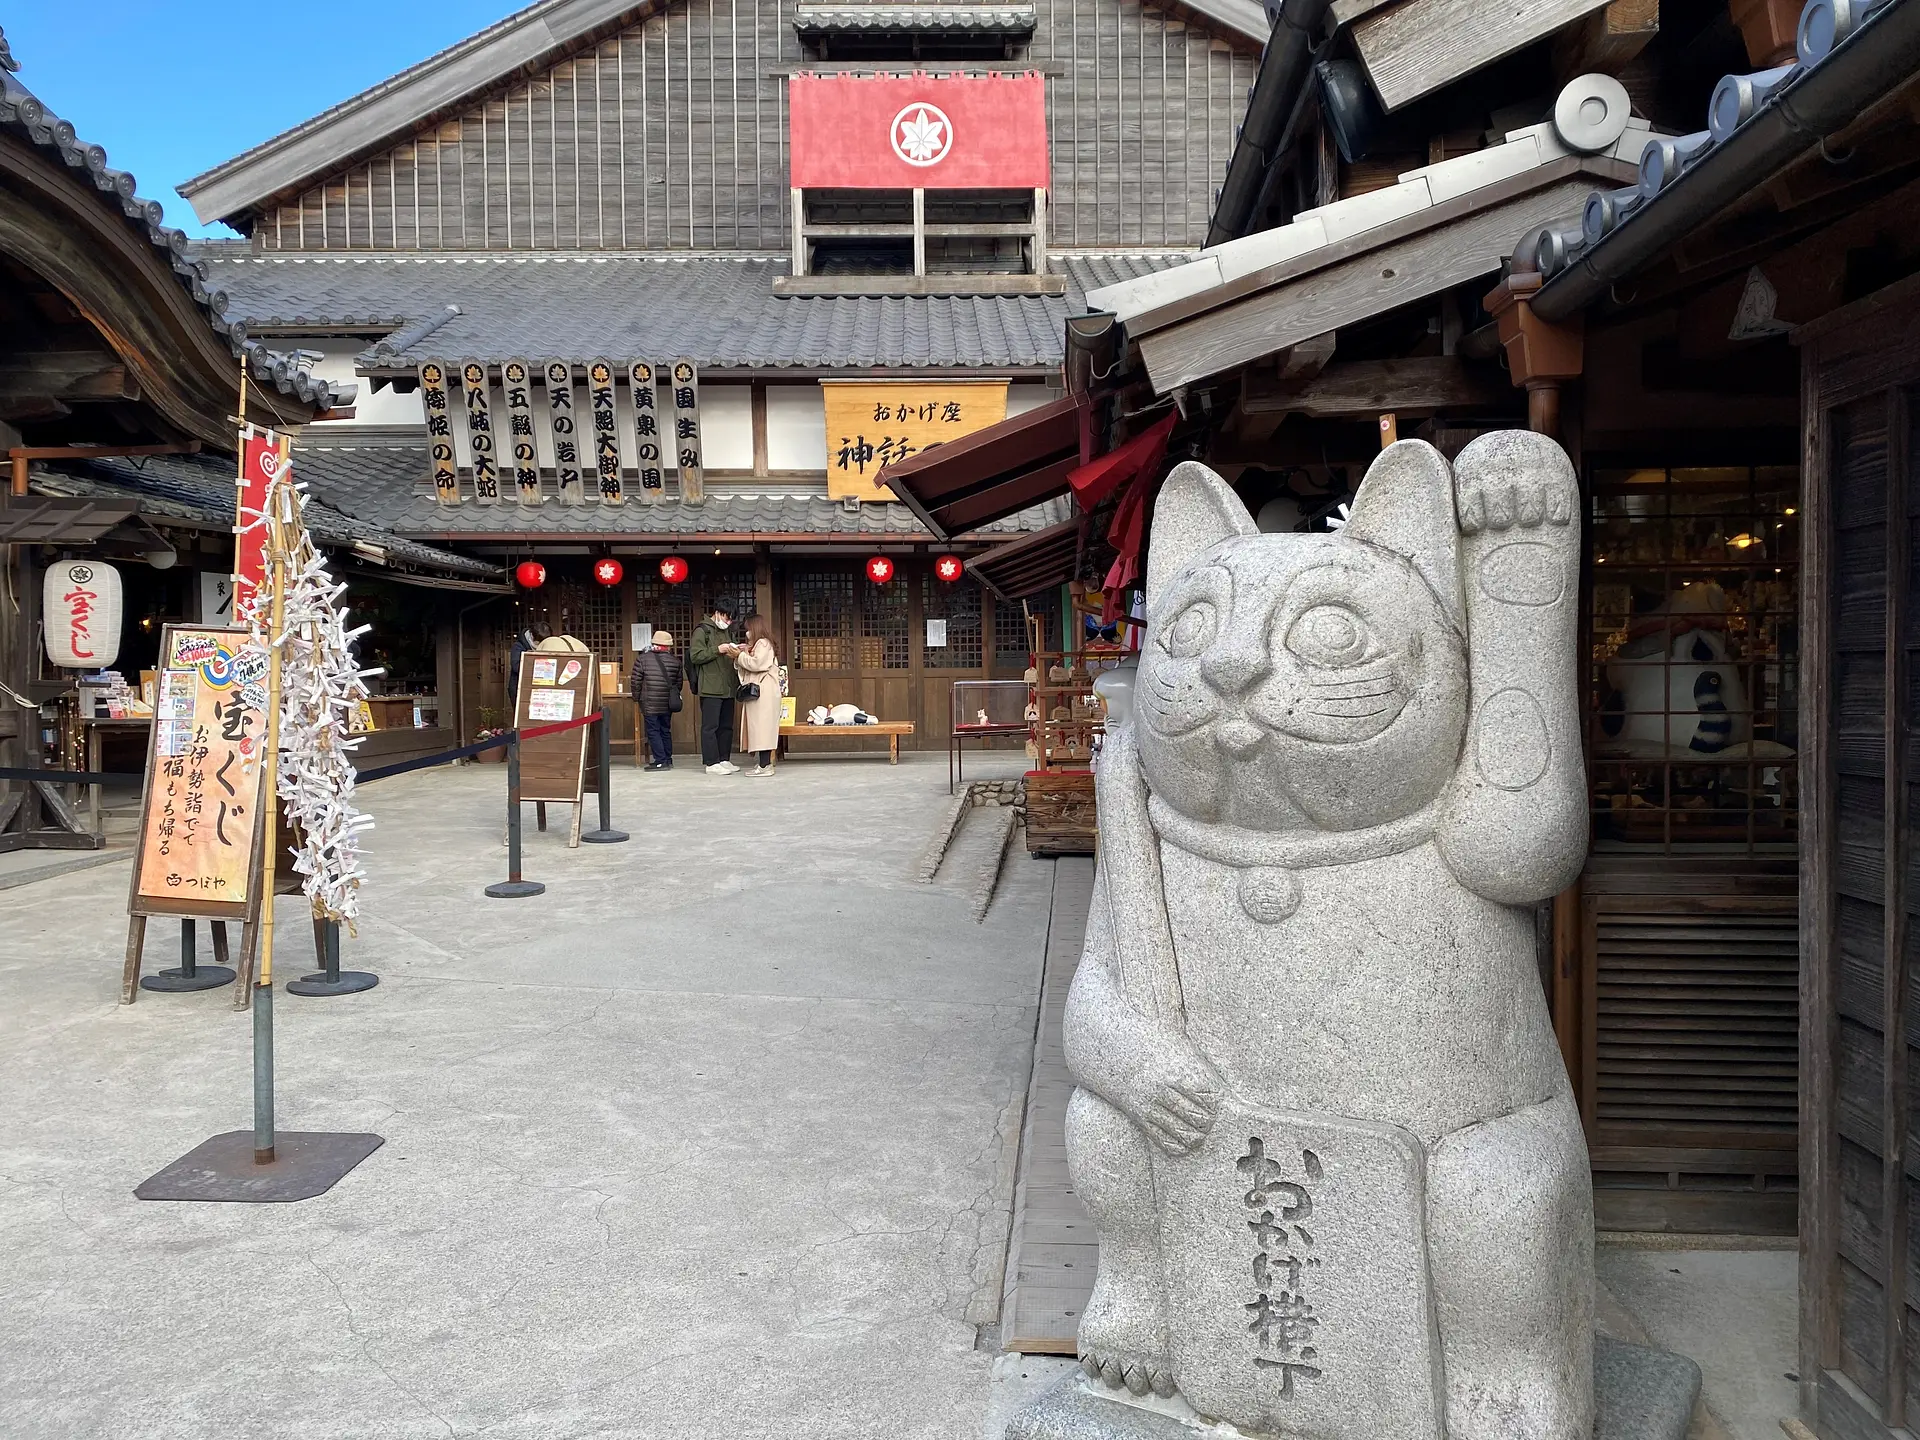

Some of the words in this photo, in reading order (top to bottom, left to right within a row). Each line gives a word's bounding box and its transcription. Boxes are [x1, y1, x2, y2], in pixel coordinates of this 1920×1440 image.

[467, 387, 498, 498] 八岐の大蛇
[508, 387, 538, 490] 五穀の神
[550, 387, 579, 489] 天の岩戸
[592, 387, 621, 498] 天照大御神
[634, 387, 662, 489] 黄泉の国
[675, 387, 700, 468] 国生み
[837, 435, 947, 475] 神話
[873, 401, 963, 423] おかげ座
[63, 585, 98, 659] 宝くじ
[158, 755, 185, 856] 福もち帰る
[183, 724, 210, 846] お伊勢詣でて
[213, 690, 258, 847] 宝くじ
[185, 876, 227, 890] つぼや
[1235, 1136, 1325, 1403] おかげ横丁
